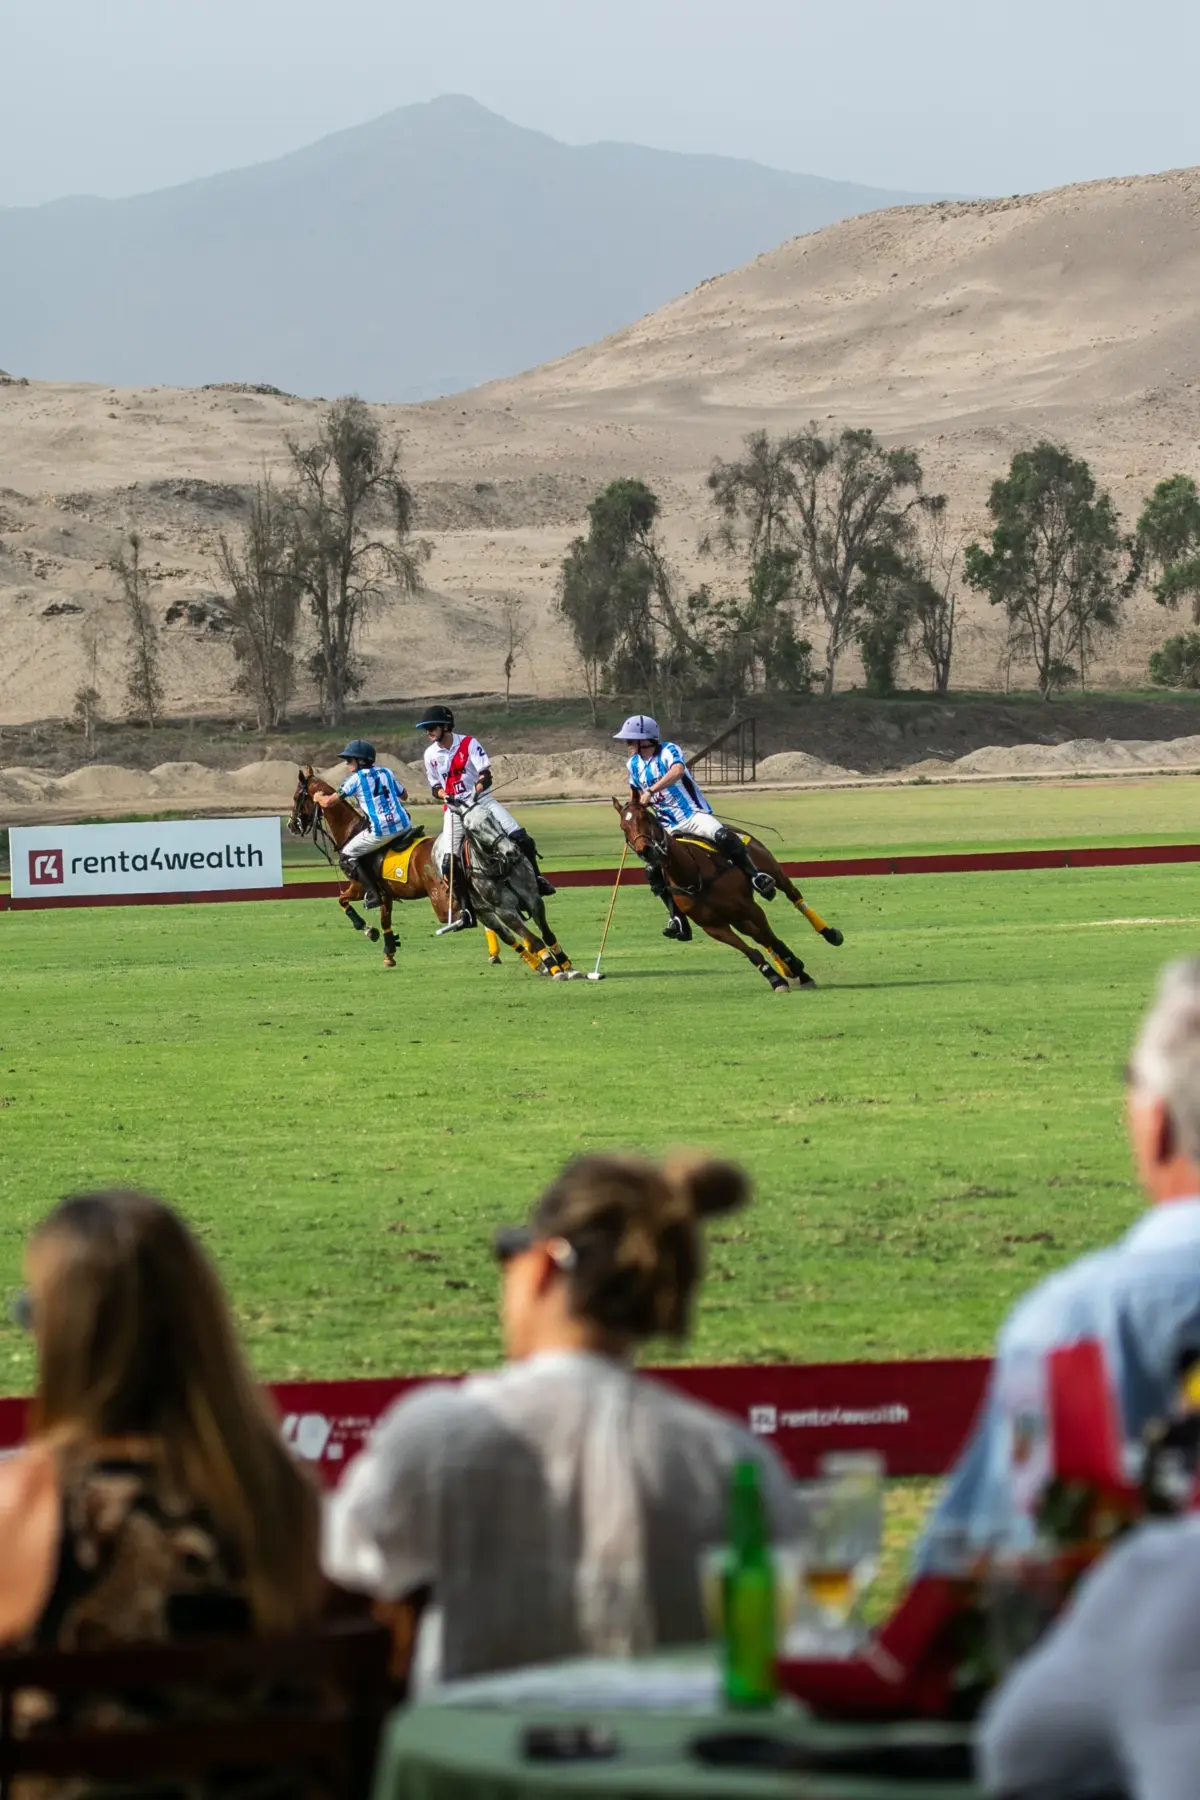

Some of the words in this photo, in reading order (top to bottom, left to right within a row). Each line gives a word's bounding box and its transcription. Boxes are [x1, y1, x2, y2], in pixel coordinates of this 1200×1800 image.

[477, 746, 486, 757] 2
[373, 777, 391, 800] 4
[71, 844, 263, 874] renta4wealth
